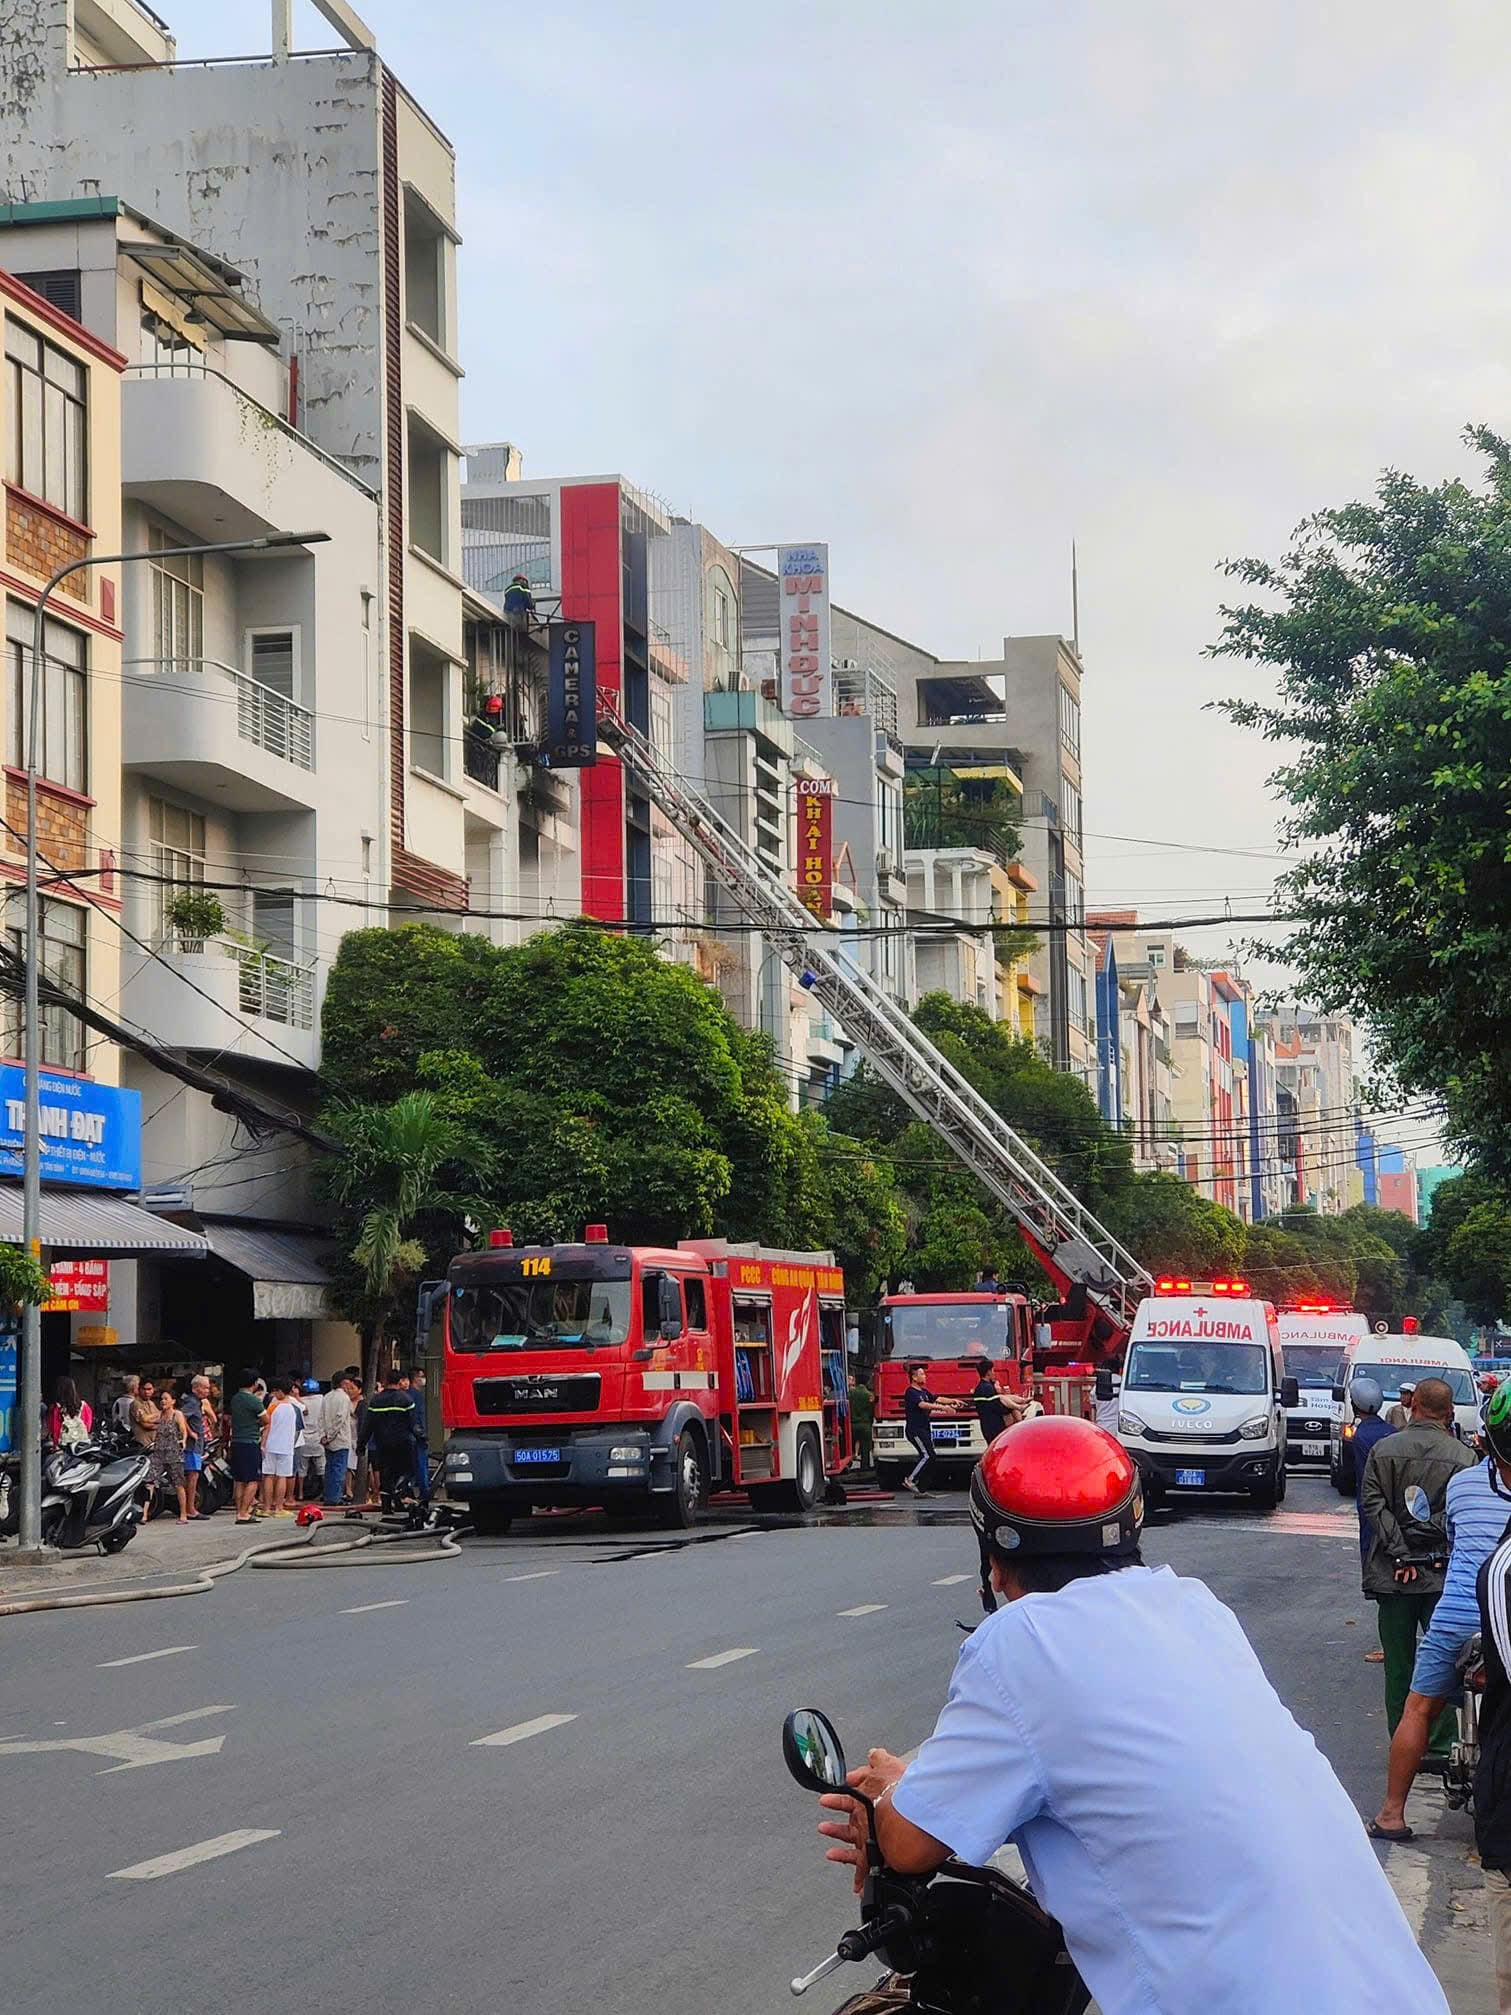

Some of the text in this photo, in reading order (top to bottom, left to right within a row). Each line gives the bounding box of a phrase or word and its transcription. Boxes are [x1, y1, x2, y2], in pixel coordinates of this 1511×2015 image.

[783, 563, 824, 576] KHOA
[563, 630, 580, 722] CAMERA
[554, 744, 591, 758] GPS
[71, 1111, 106, 1149] ĐẠT
[520, 1257, 552, 1276] 114
[740, 1264, 761, 1284] PCCC
[514, 1387, 558, 1399] MAN
[1171, 1418, 1213, 1429] IVECO
